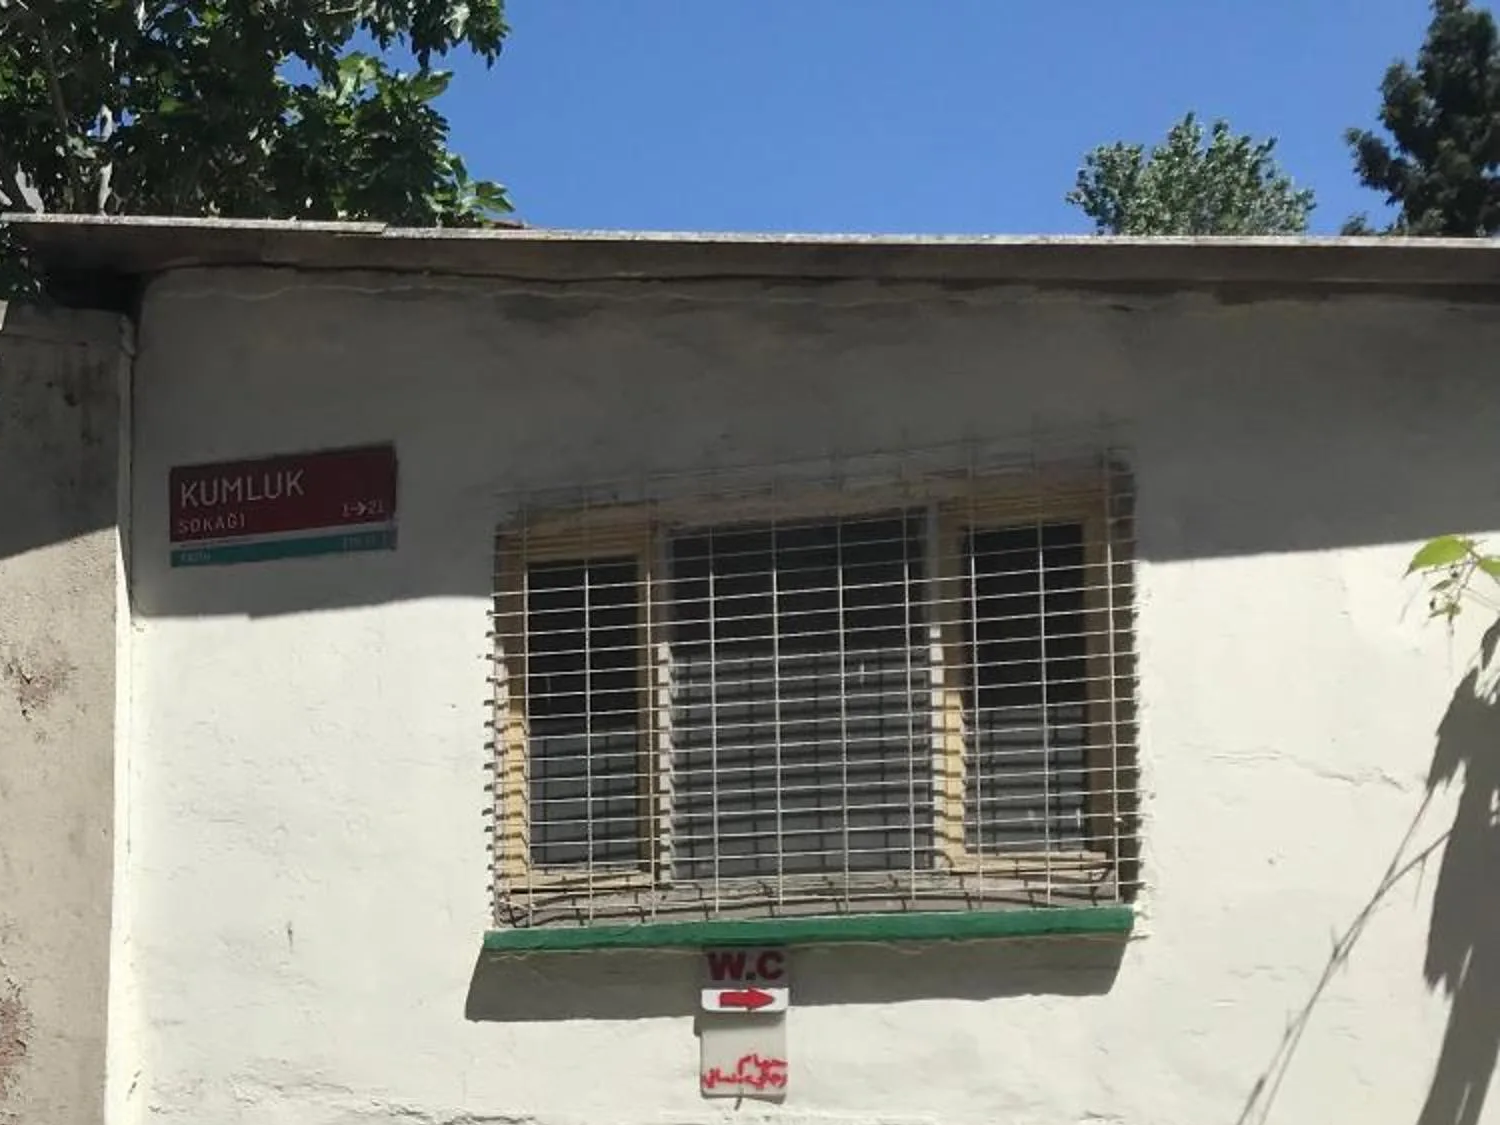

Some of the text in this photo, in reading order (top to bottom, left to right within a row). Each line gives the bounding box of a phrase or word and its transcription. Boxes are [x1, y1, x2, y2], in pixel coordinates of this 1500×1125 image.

[180, 468, 305, 508] KUMLUK
[179, 512, 245, 534] SOKAĞI
[708, 950, 785, 981] W.C
